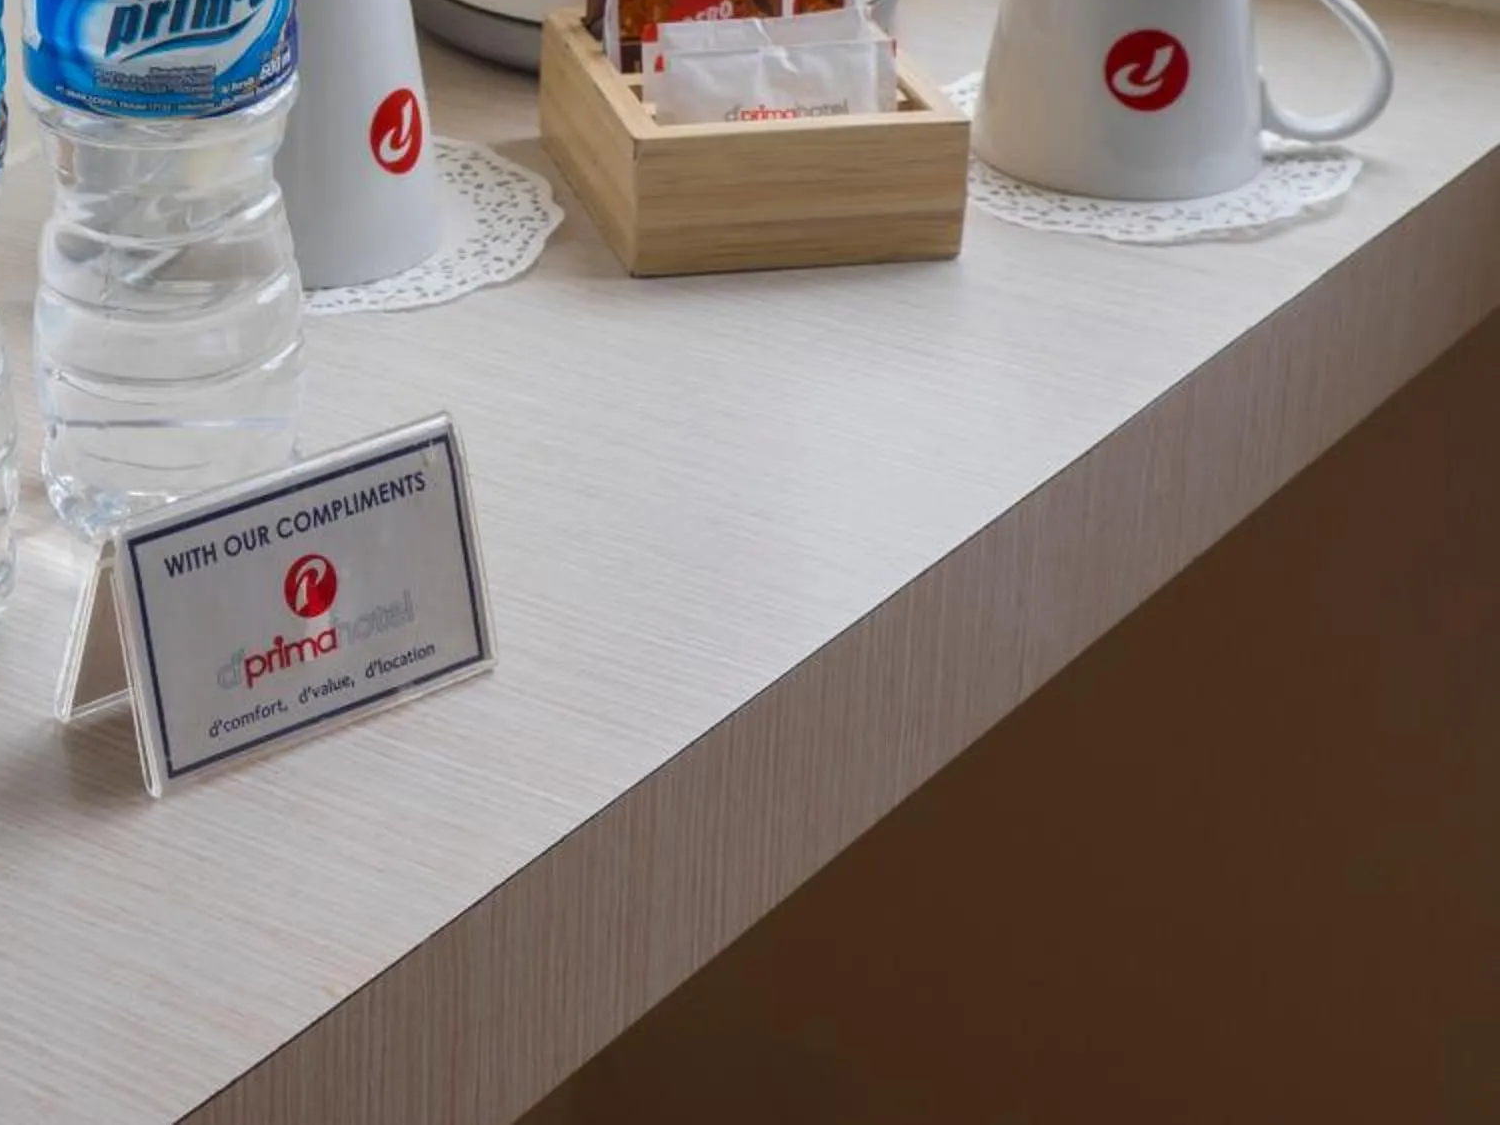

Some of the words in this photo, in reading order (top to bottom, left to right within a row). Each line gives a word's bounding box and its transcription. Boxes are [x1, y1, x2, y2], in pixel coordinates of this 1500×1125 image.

[163, 542, 218, 578] WITH
[223, 526, 271, 558] OUR
[275, 472, 426, 539] COMPLIMENTS
[208, 698, 289, 738] d'comfort,
[298, 673, 355, 705] d'value,
[364, 642, 436, 679] d'location
